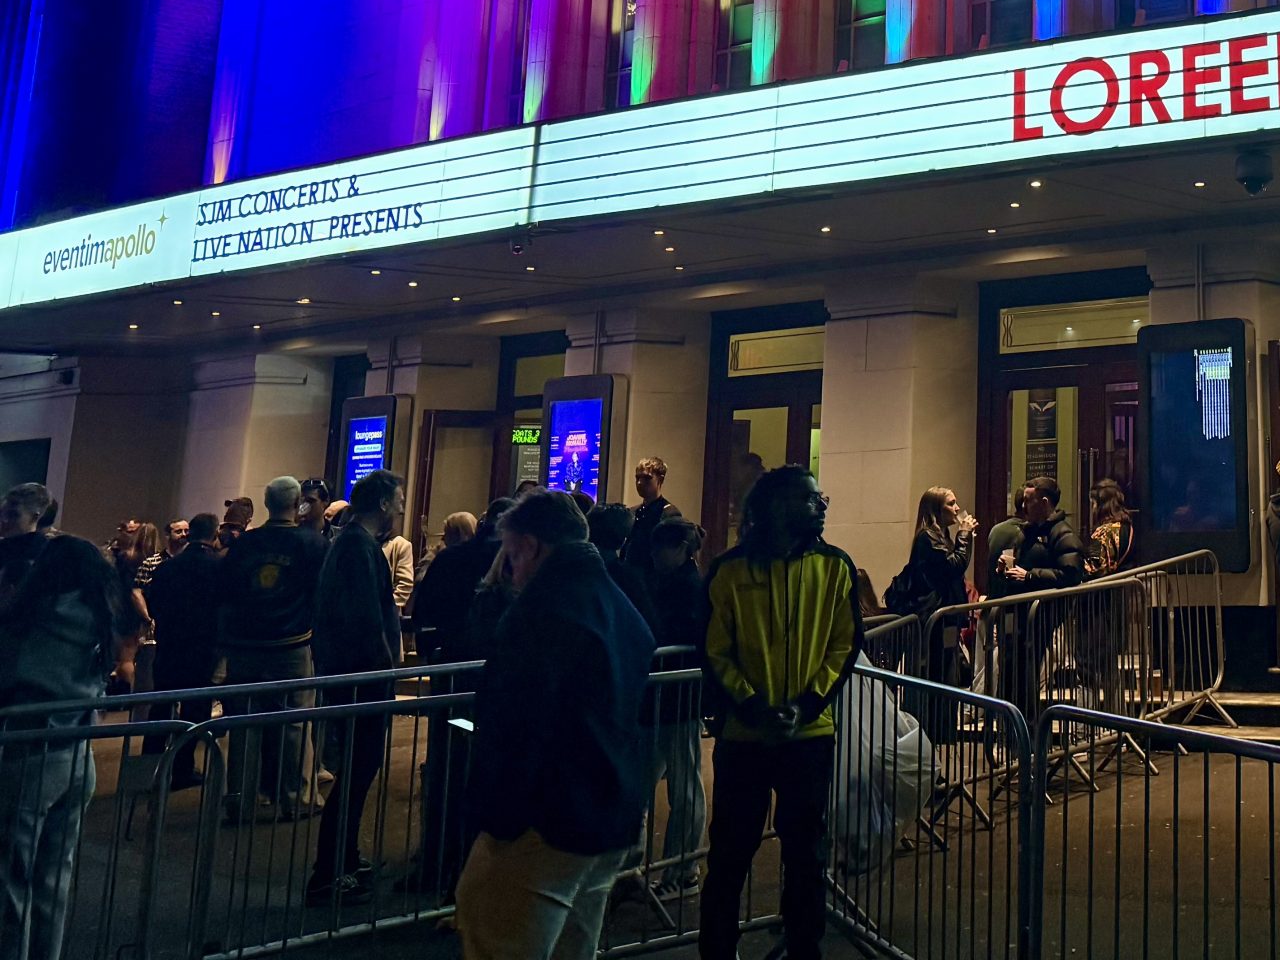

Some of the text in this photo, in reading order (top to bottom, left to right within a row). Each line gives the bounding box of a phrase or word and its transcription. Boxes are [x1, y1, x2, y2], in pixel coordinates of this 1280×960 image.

[196, 174, 360, 226] SJM CONCERTS &
[191, 202, 423, 262] LIVE NATION PRESENTS
[511, 435, 538, 444] POUNDS
